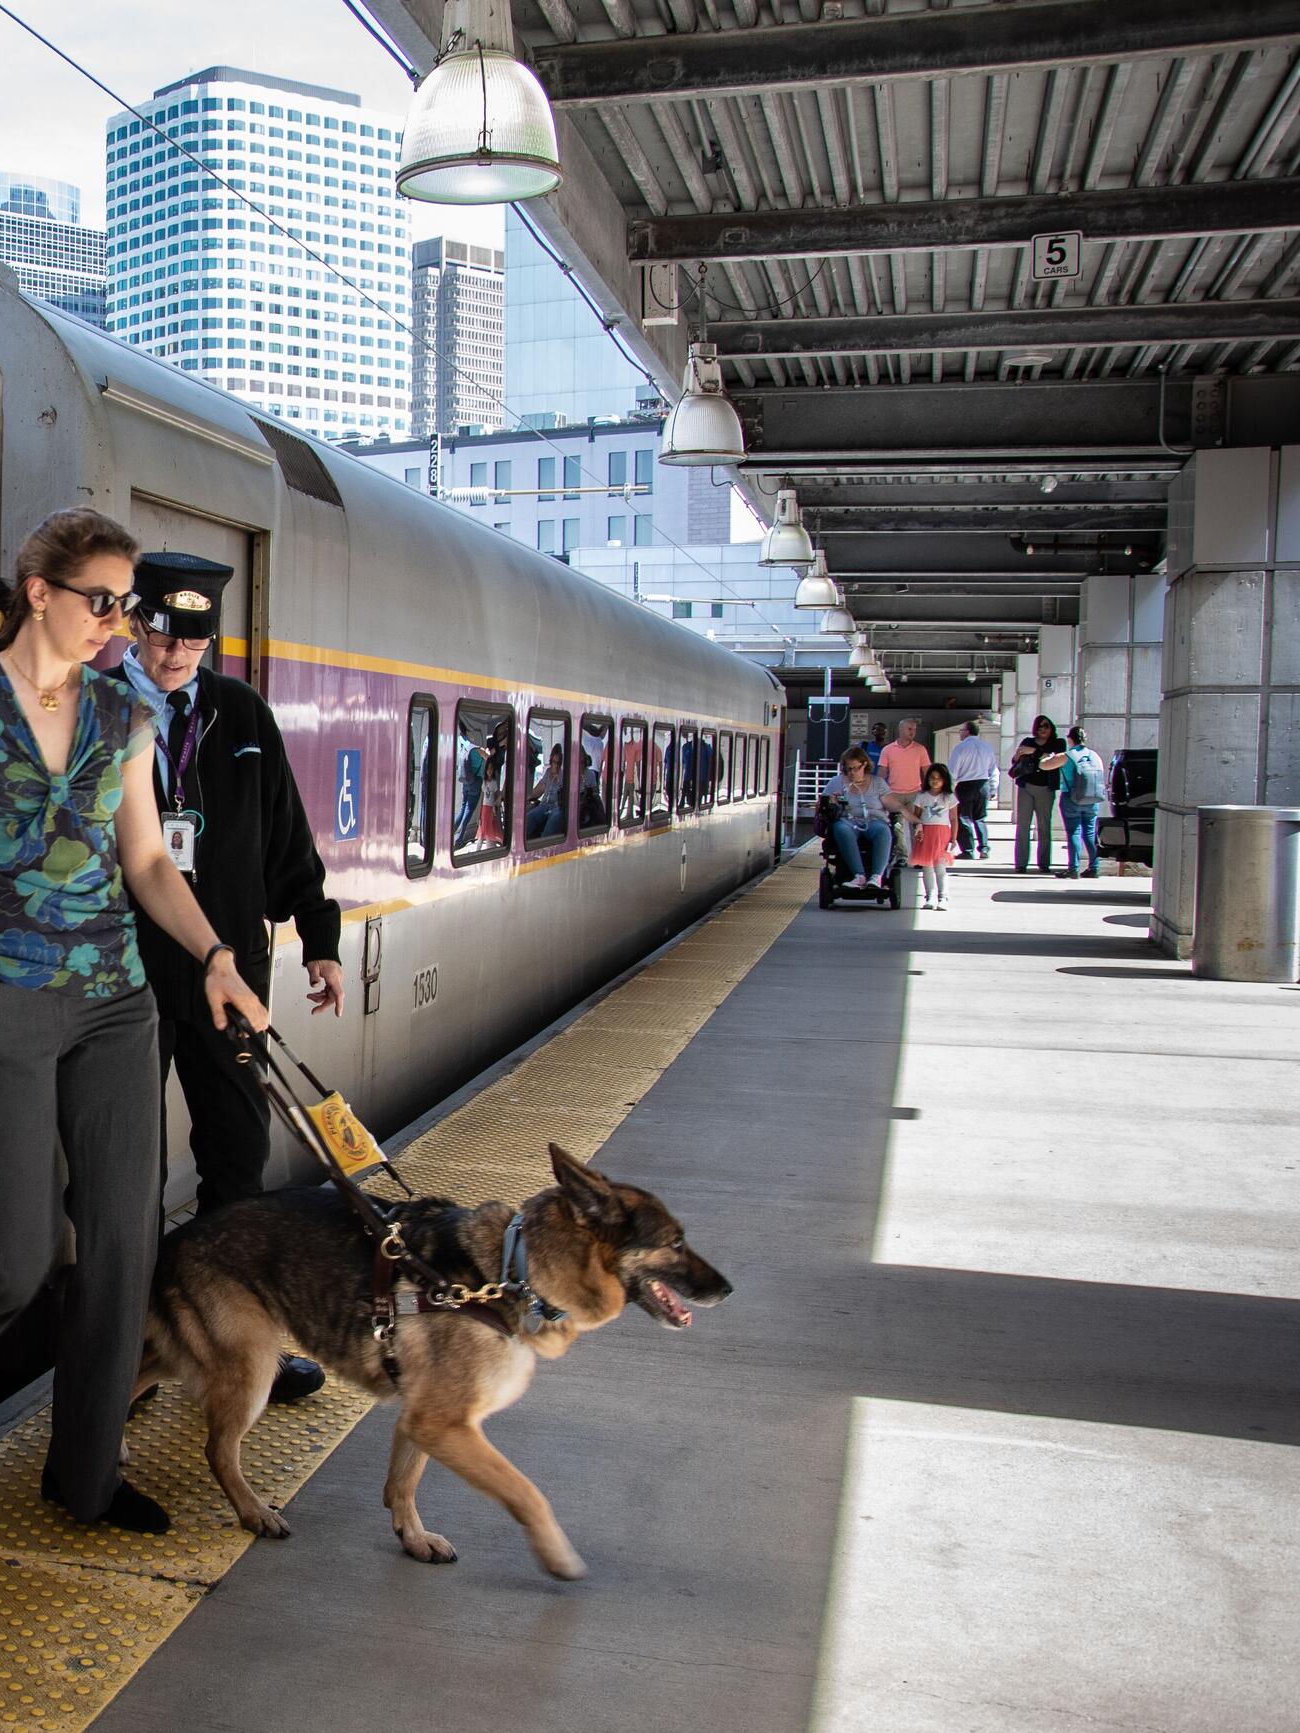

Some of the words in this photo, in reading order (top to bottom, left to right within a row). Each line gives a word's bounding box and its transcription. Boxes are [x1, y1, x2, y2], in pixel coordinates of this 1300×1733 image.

[1046, 238, 1066, 265] 5
[1043, 266, 1069, 275] CARS
[430, 440, 438, 482] 228
[1045, 679, 1052, 688] 6
[414, 966, 437, 1008] 1530
